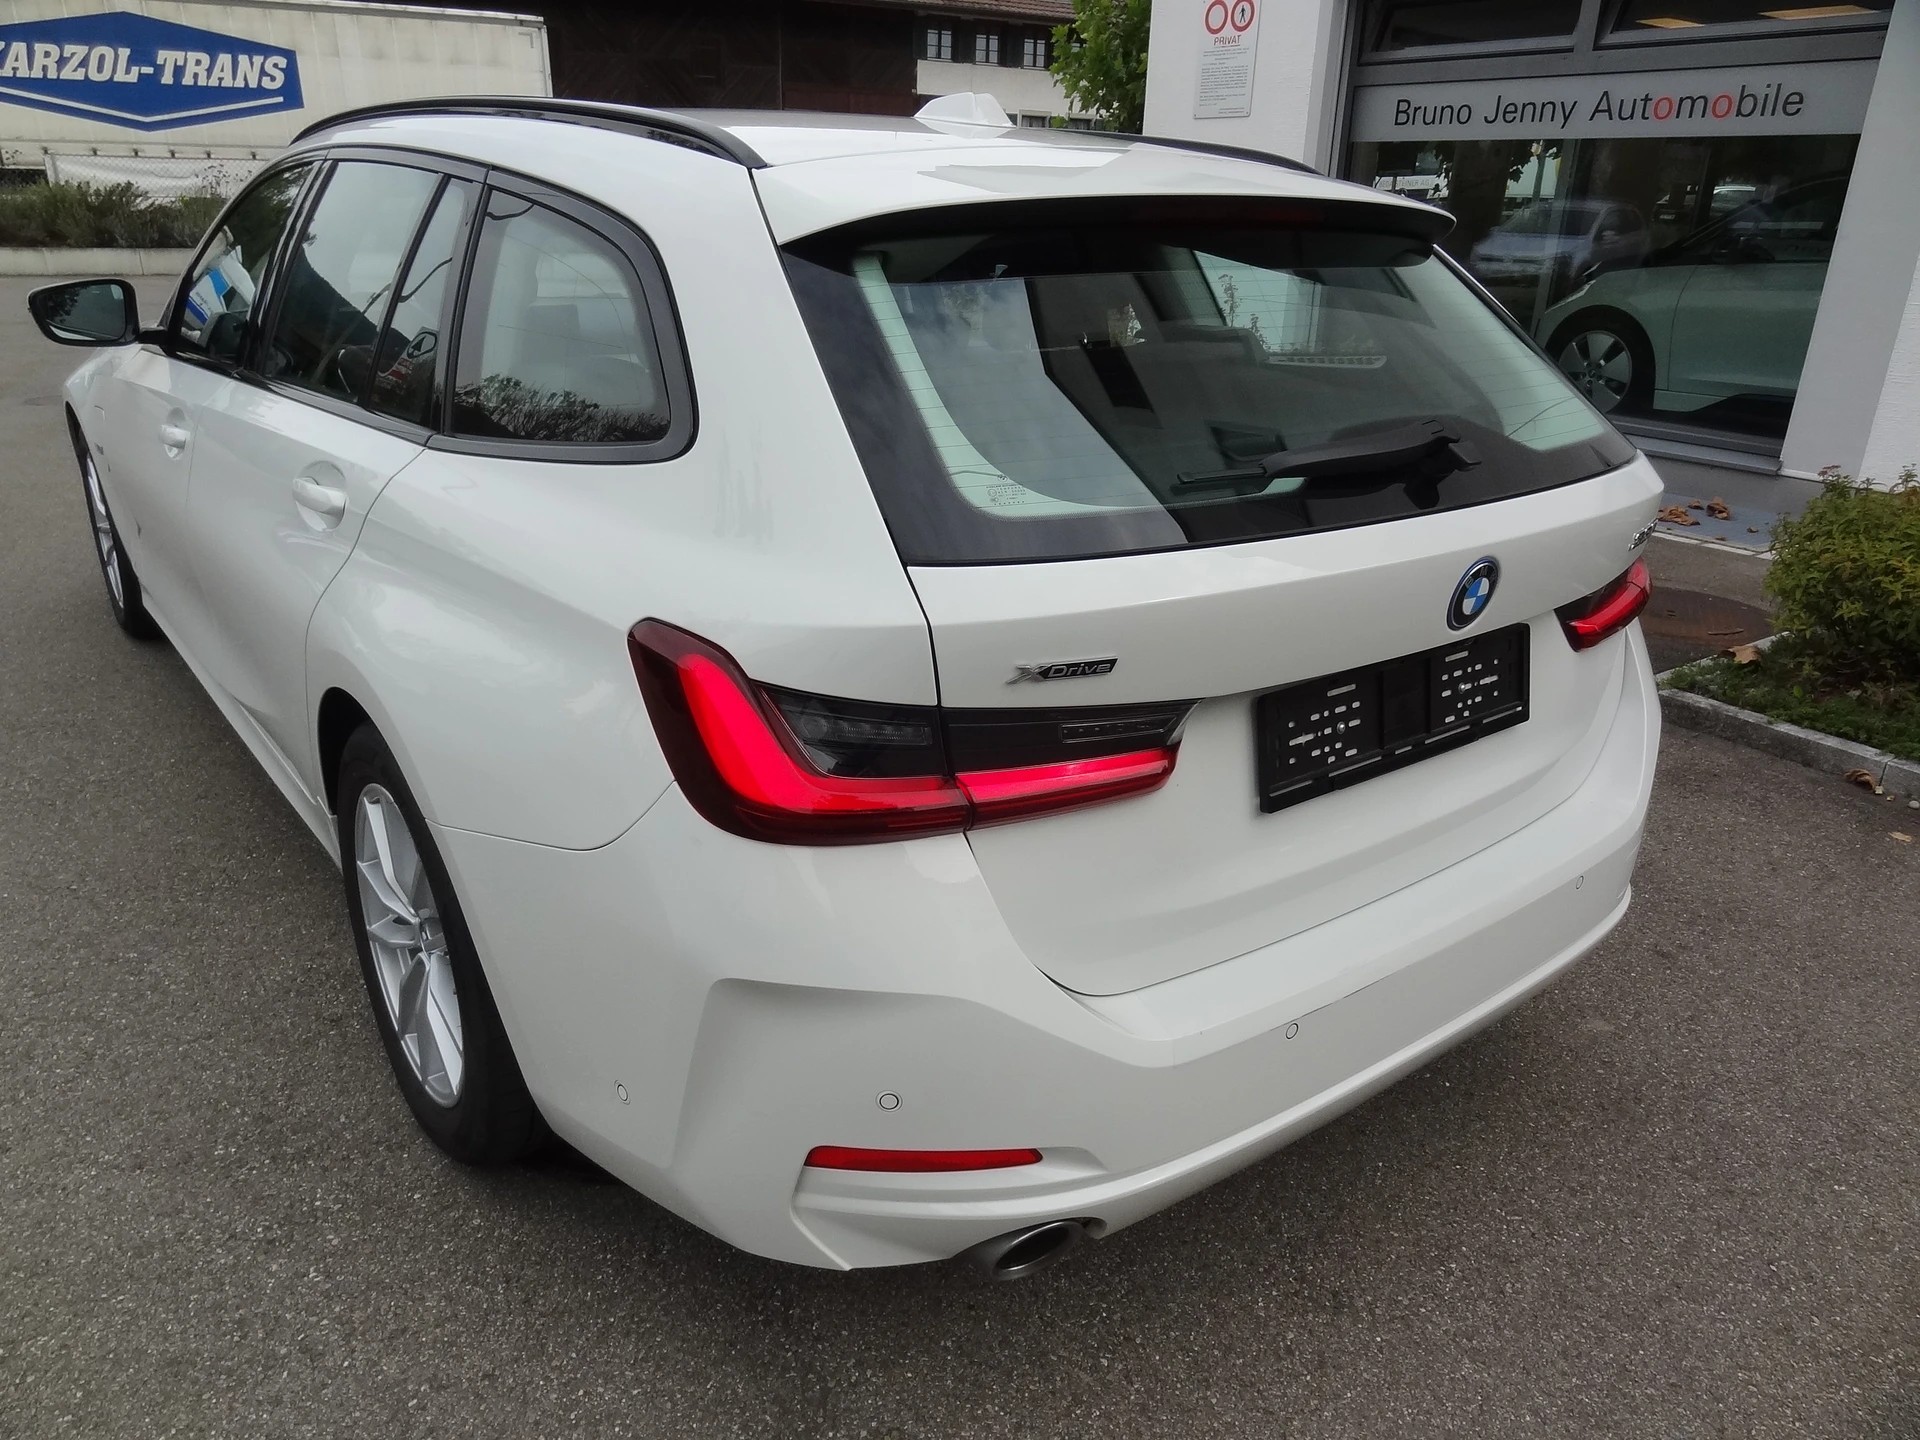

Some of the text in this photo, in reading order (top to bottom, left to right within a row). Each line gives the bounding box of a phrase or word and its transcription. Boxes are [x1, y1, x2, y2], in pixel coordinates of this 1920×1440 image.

[1213, 34, 1242, 46] PRIVAT
[0, 41, 288, 91] ARZOL-TRANS
[1394, 83, 1805, 130] Bruno Jenny Automobile
